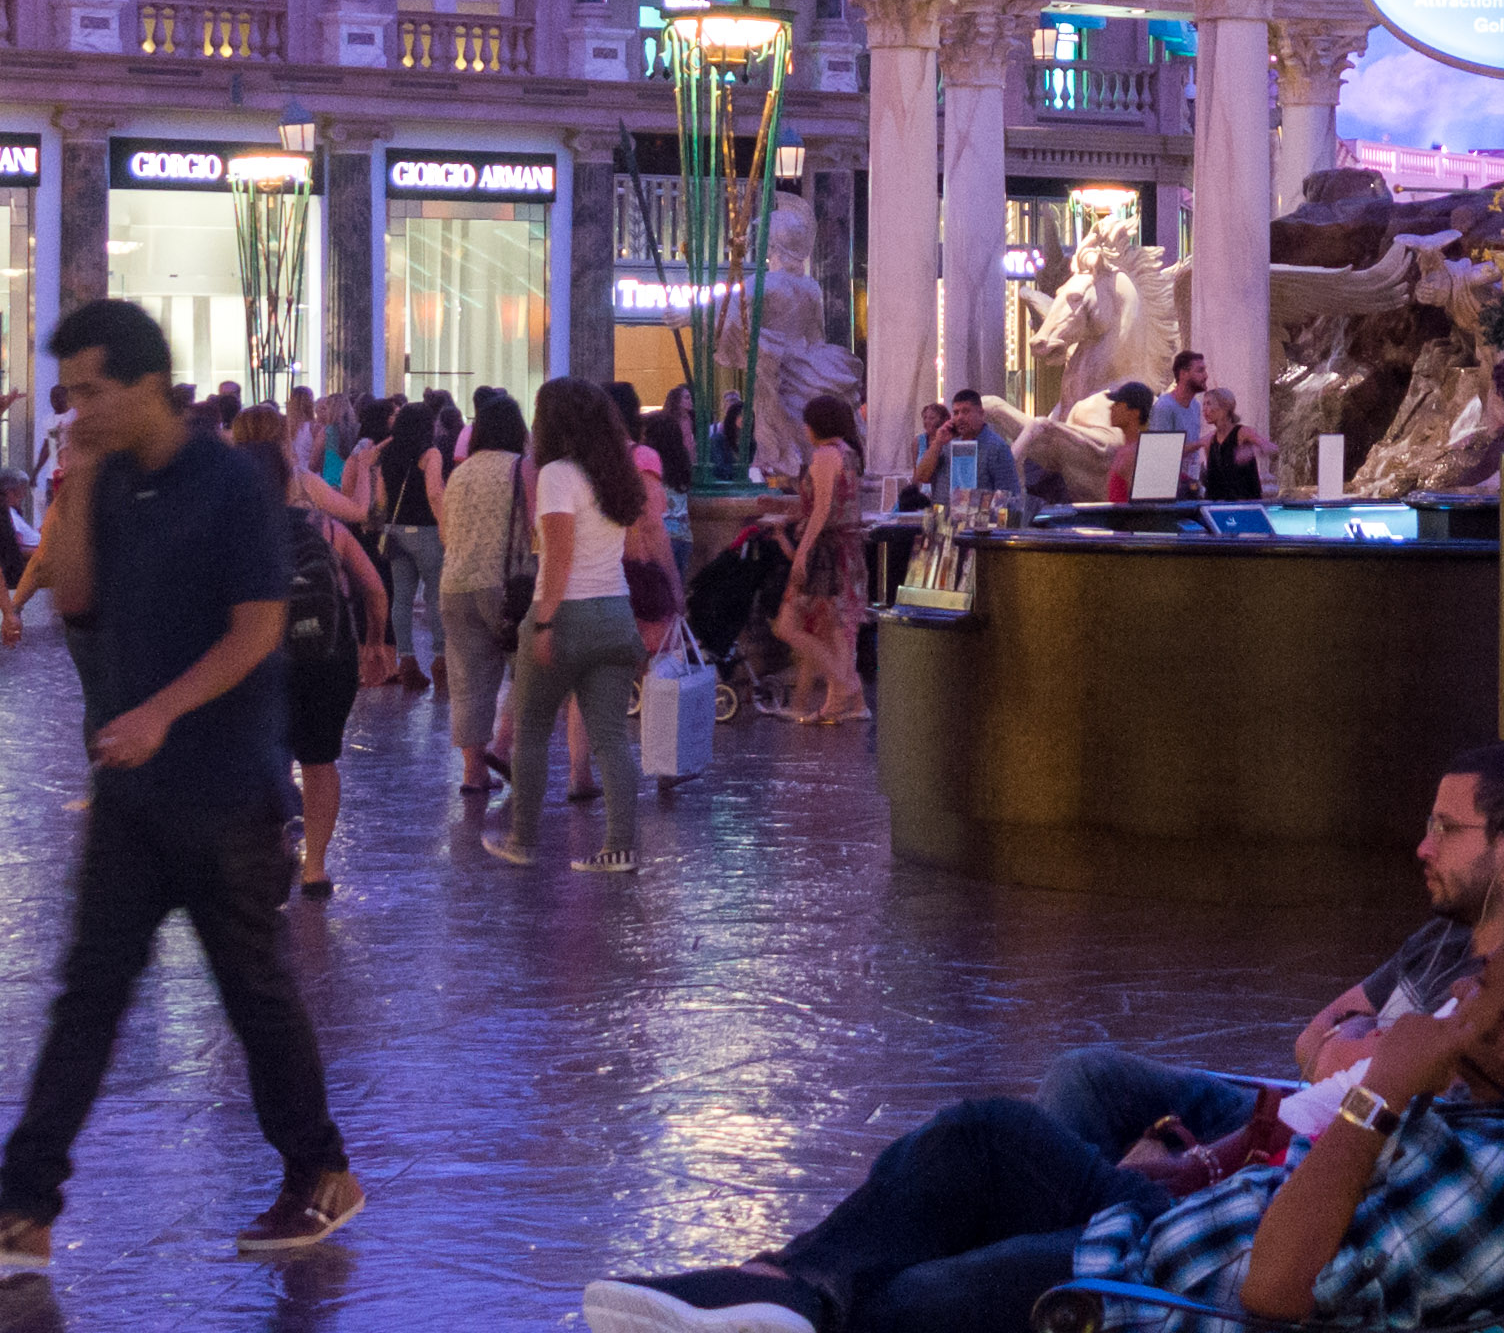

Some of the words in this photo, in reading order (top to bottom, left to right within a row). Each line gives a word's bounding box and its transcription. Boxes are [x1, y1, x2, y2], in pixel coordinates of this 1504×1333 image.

[132, 152, 223, 179] GIORGIO
[392, 161, 476, 188] GIORGIO
[479, 164, 554, 190] ARMANI
